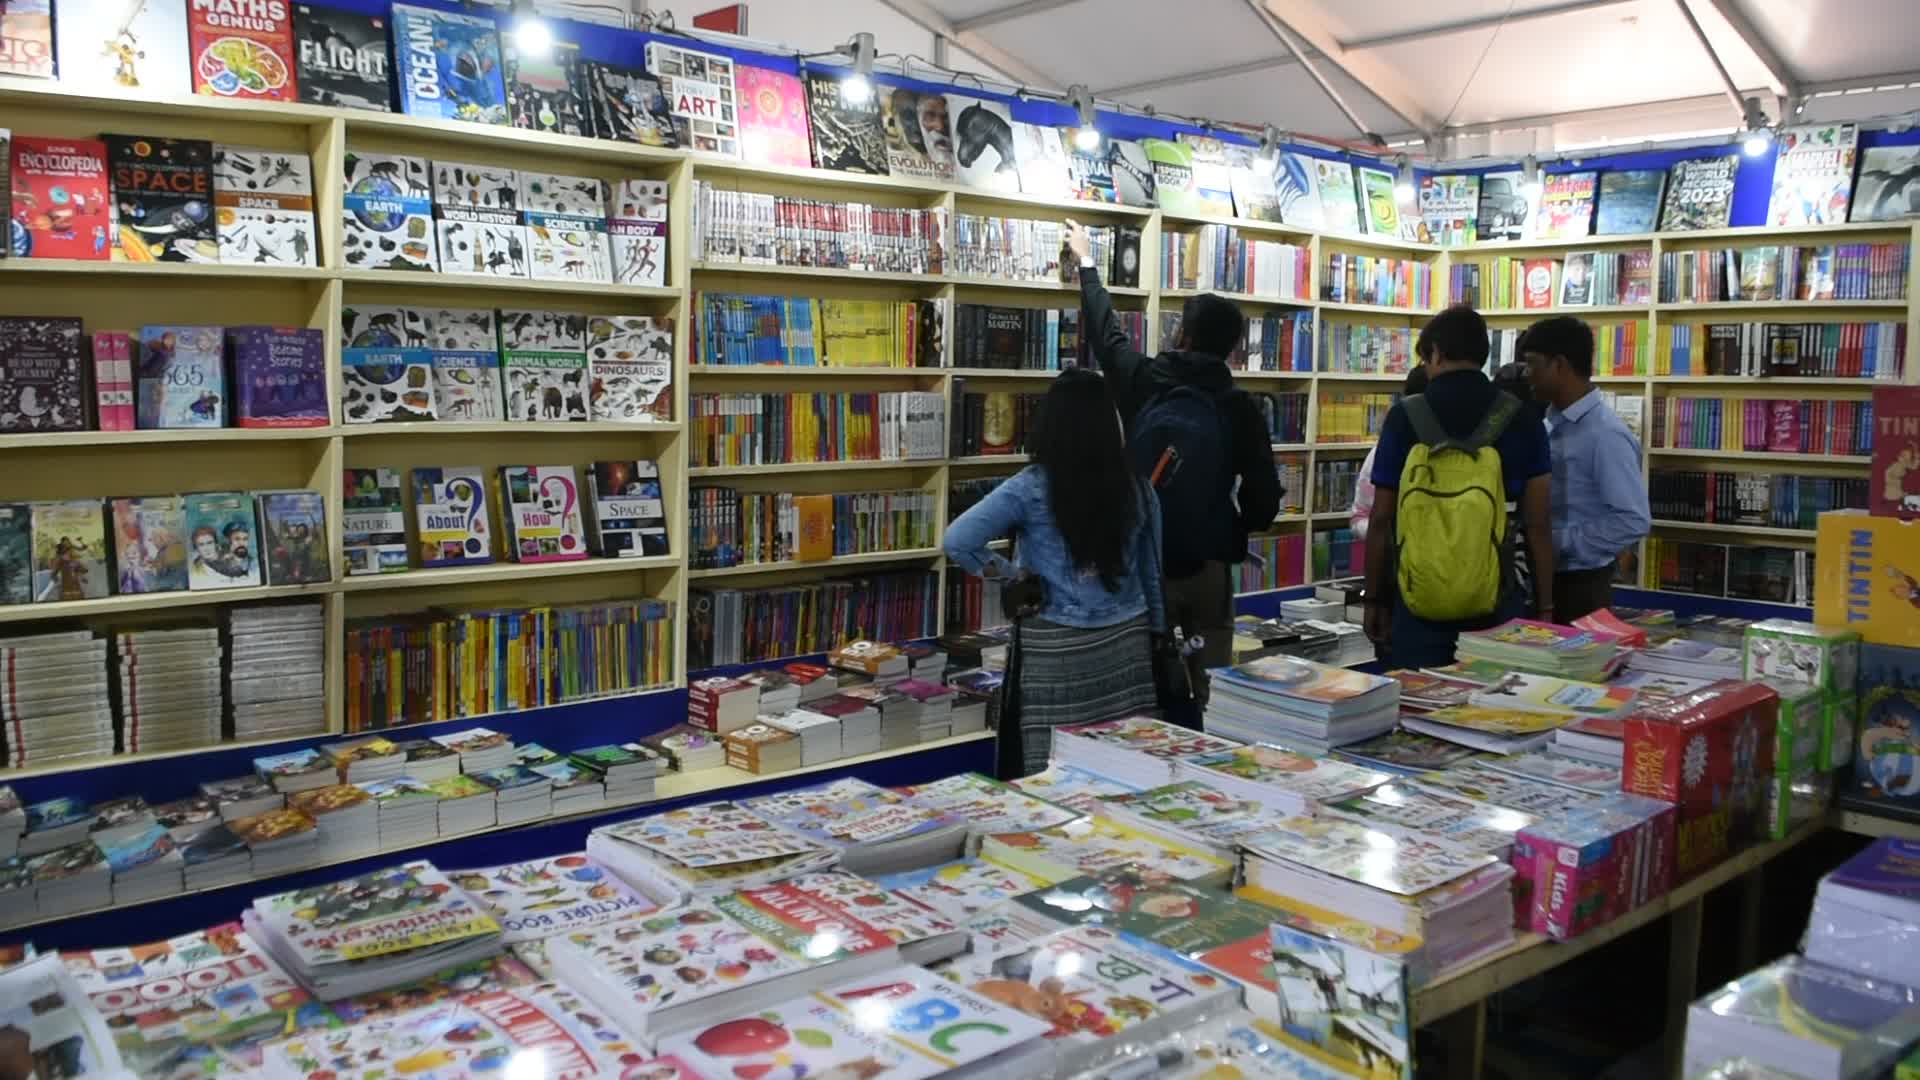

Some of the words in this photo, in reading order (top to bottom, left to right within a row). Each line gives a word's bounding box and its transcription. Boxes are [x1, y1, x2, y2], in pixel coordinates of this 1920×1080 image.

[193, 0, 287, 21] MATHS
[206, 13, 276, 33] GENIUS
[300, 39, 387, 76] FLIGHT
[407, 15, 441, 100] OCEAN!
[677, 95, 717, 116] ART
[19, 153, 104, 172] ENCYCLOPEDIA
[889, 156, 955, 174] EVOLUTION
[117, 170, 208, 193] SPACE
[1679, 187, 1726, 204] 2023
[363, 200, 404, 214] EARTH
[443, 209, 478, 223] WORLD
[478, 212, 518, 226] HISTORY
[544, 219, 586, 231] SCIENCE
[627, 225, 656, 237] BODY
[987, 319, 1023, 330] MARTIN
[364, 353, 404, 365] EARTH
[433, 356, 477, 368] SCIENCE
[506, 356, 547, 368] ANIMAL
[547, 357, 583, 369] WORLD
[594, 365, 665, 377] DINOSAURS
[1879, 416, 1920, 436] TIN
[1847, 529, 1874, 623] TINTIN
[557, 896, 638, 922] PICTURE
[504, 911, 556, 931] BOO
